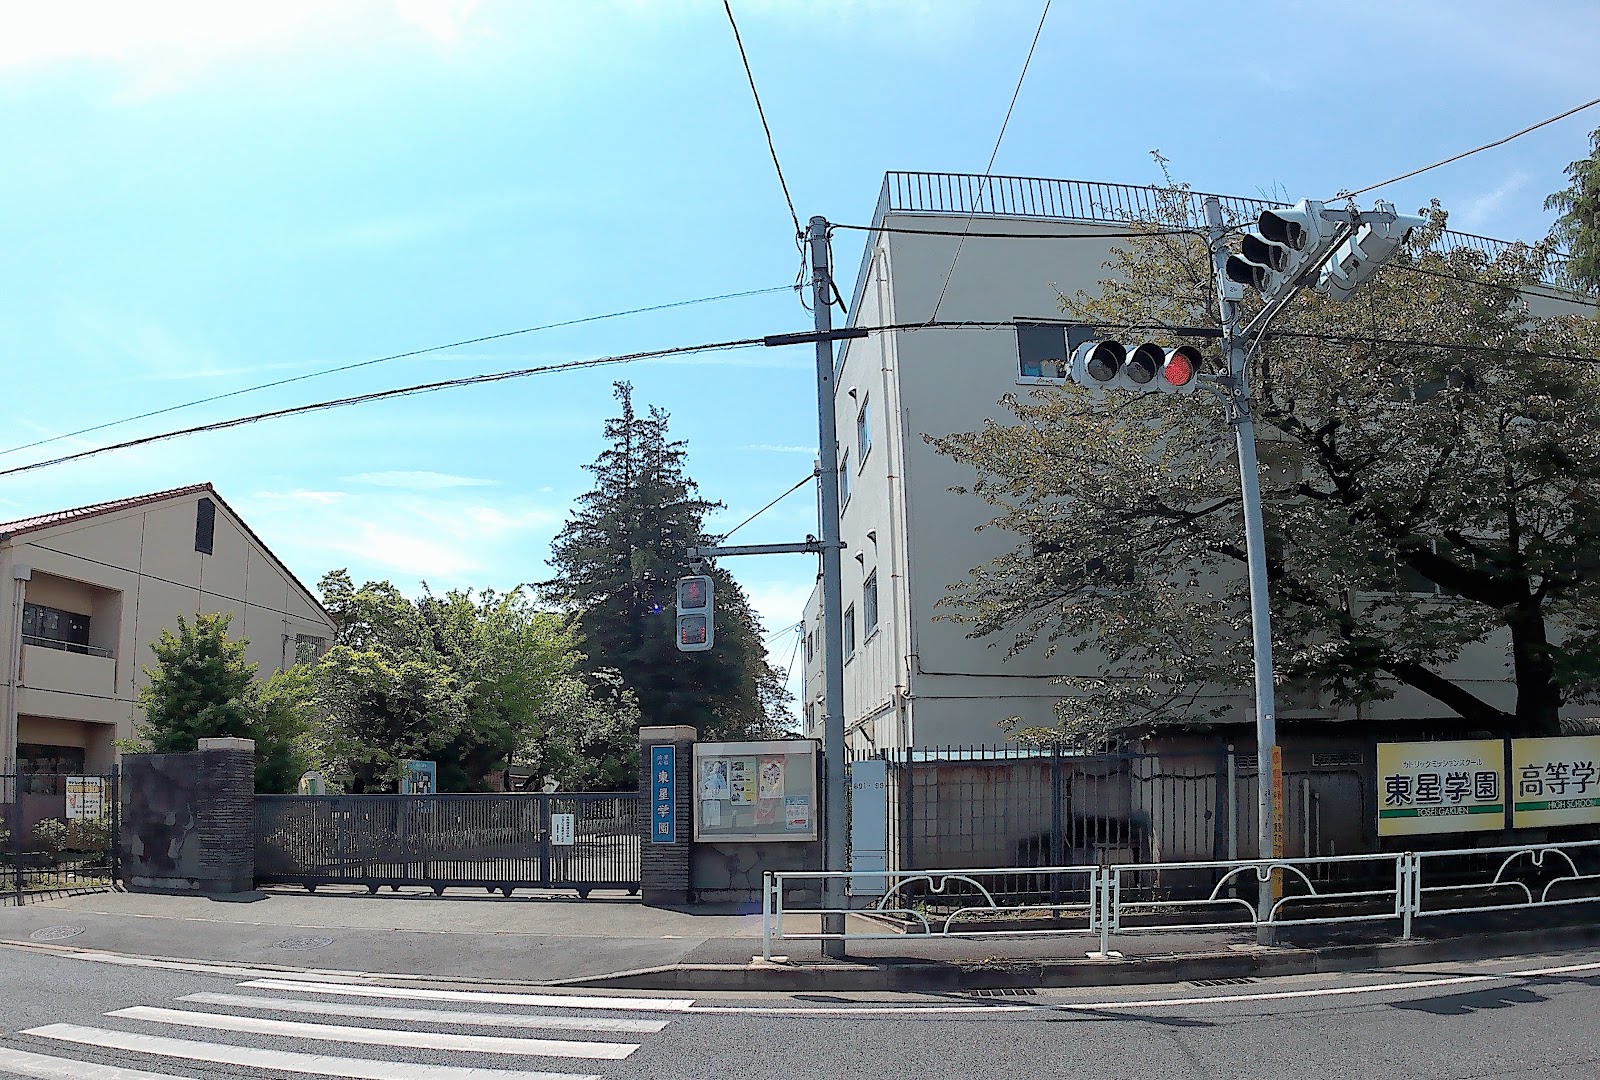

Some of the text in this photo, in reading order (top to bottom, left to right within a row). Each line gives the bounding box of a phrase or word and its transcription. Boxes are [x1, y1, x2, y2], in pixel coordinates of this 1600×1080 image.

[1402, 758, 1483, 769] カトリックミッションスクール
[1384, 771, 1500, 805] 東星学園
[1518, 760, 1600, 797] 高等学
[657, 770, 670, 835] 東星学園
[1416, 806, 1469, 817] TOSEI GAKUEN
[1547, 800, 1566, 810] HIGH
